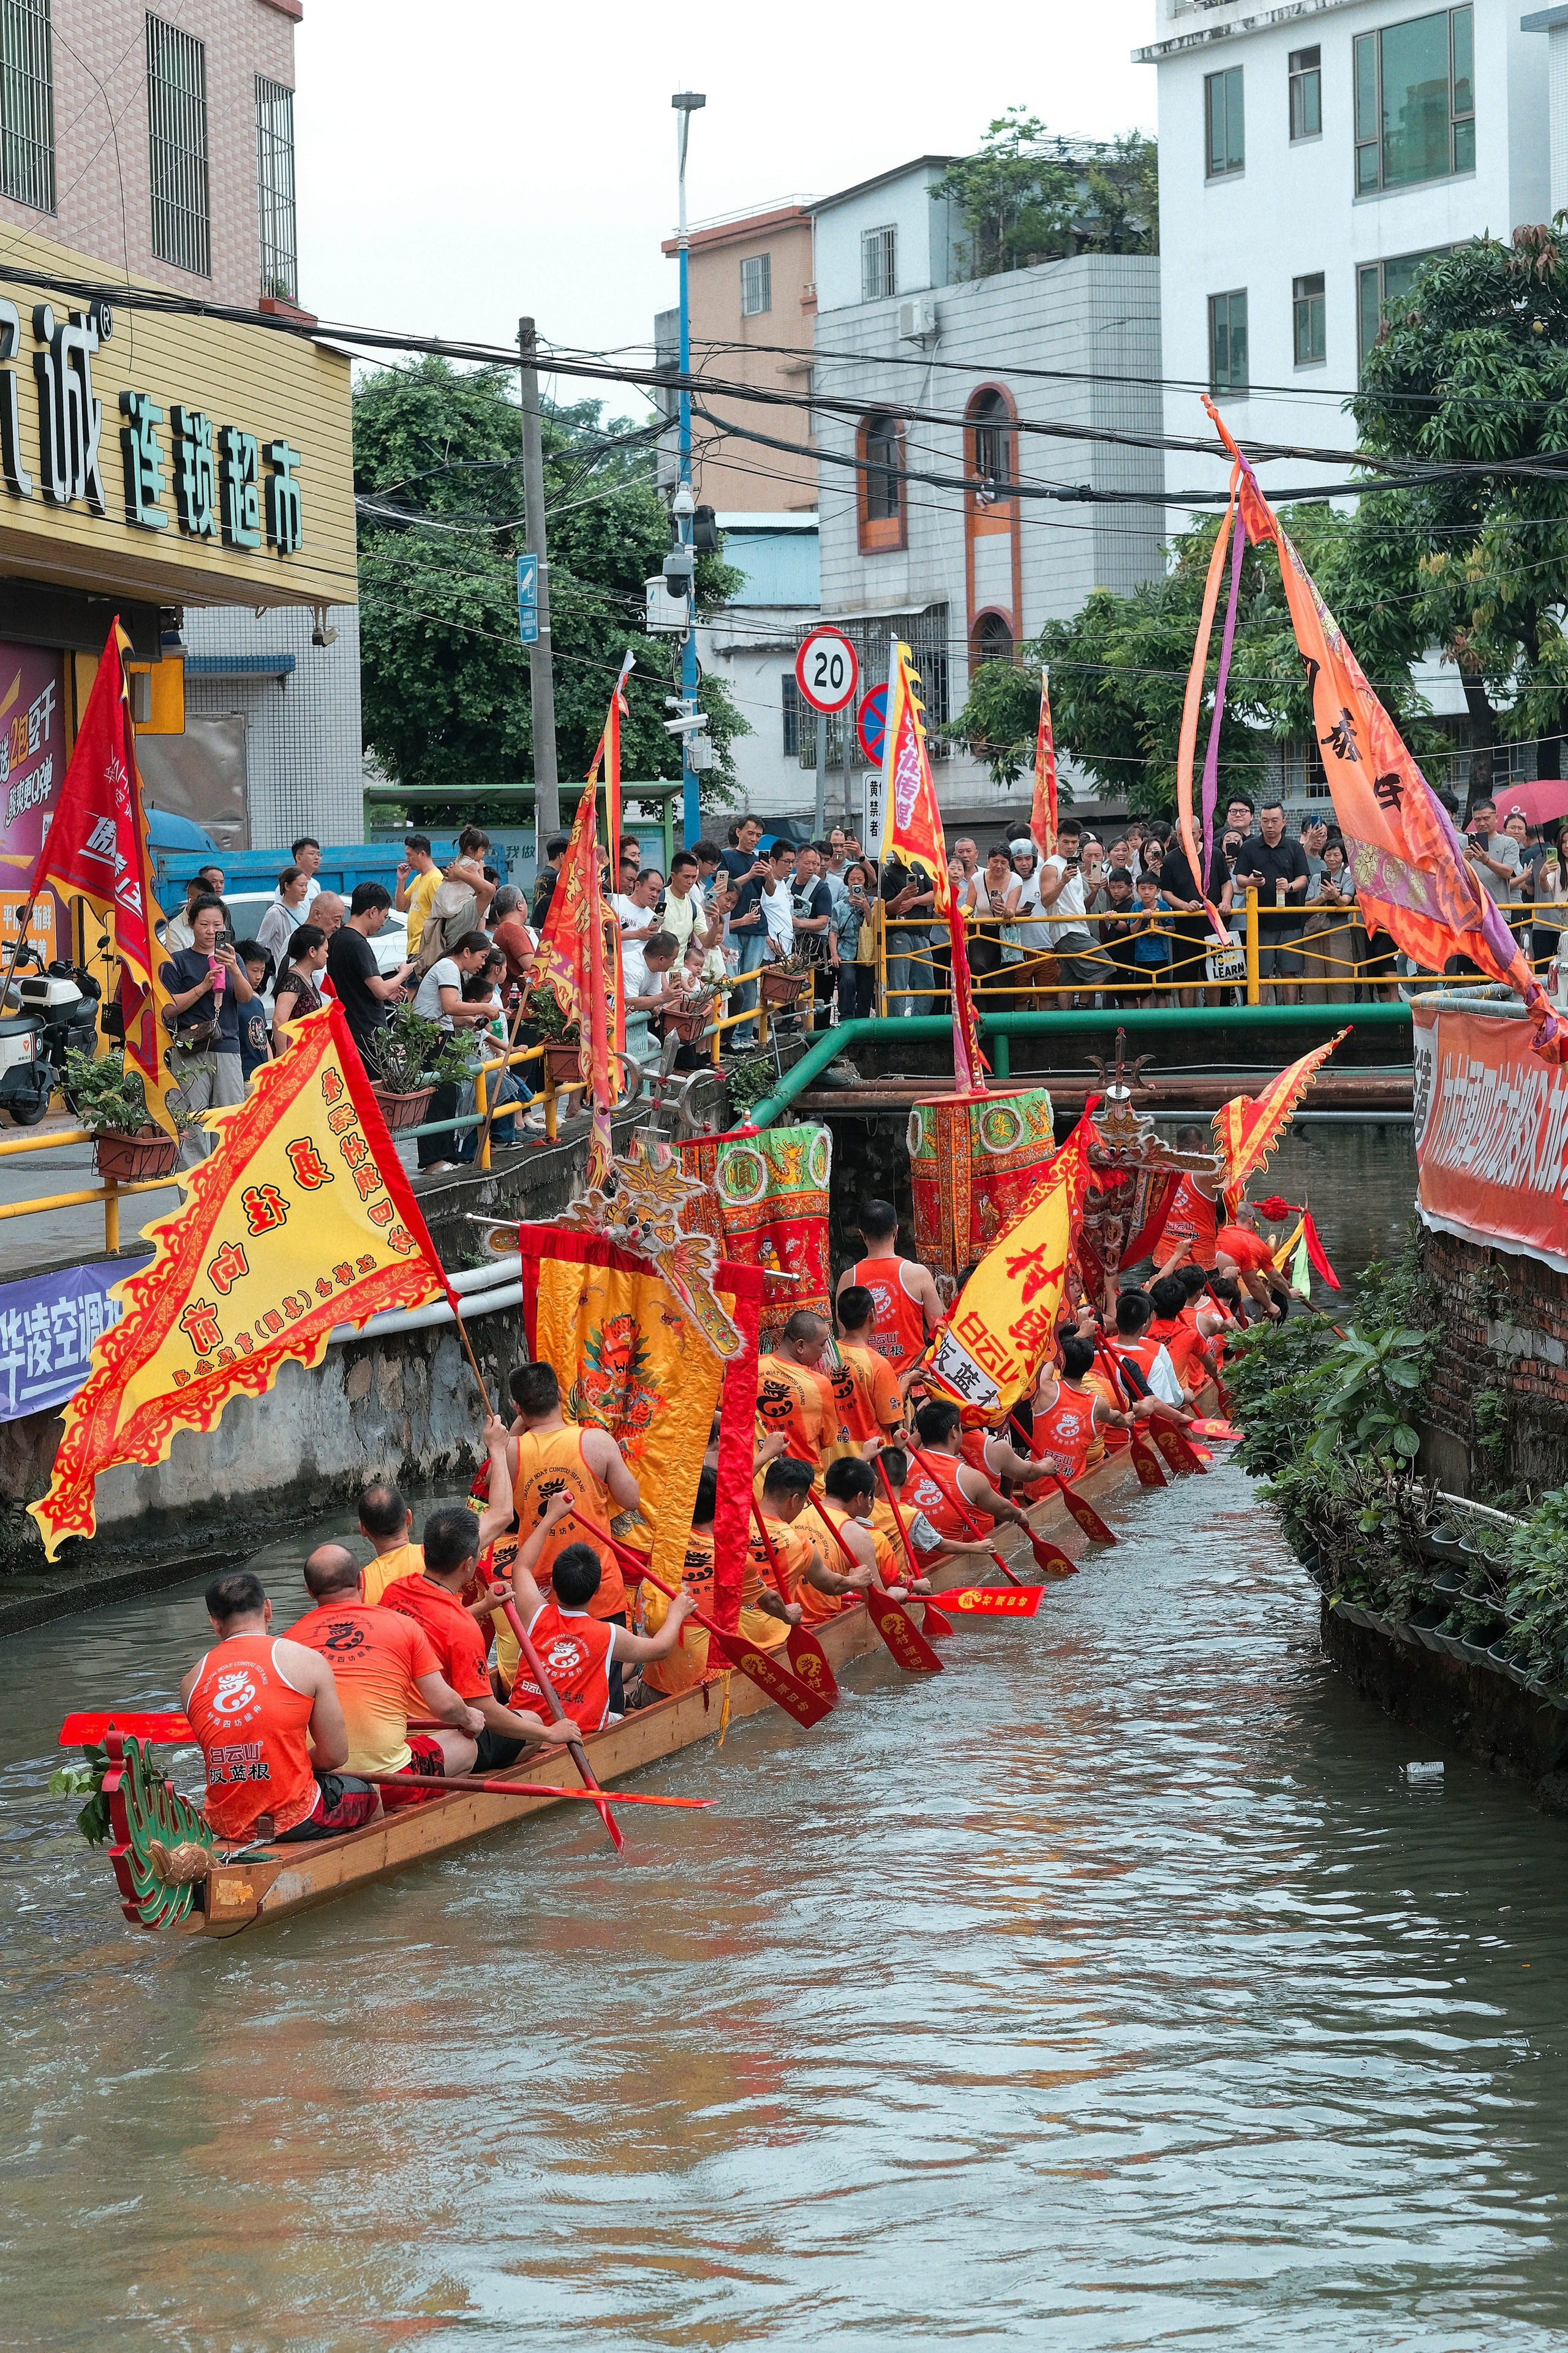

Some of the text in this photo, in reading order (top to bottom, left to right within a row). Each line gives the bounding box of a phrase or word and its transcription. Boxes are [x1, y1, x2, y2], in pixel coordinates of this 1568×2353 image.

[119, 391, 302, 555] 连锁超市
[814, 652, 843, 689] 20
[5, 752, 53, 827] 酸爽更Q弹
[33, 905, 51, 931] 新鲜
[1211, 954, 1224, 967] TO
[1213, 962, 1244, 979] LEARN
[990, 1115, 1011, 1141] 安
[728, 1159, 754, 1189] 順
[957, 1312, 1020, 1384] 白云山
[796, 1386, 805, 1405] SIFANG
[524, 1478, 534, 1500] DRAGON
[533, 1469, 548, 1479] BOAT
[570, 1472, 585, 1492] SIFANG
[981, 1595, 1028, 1607] 村頭四坊
[217, 1663, 233, 1673] BOAT
[255, 1665, 268, 1685] SIFANG
[763, 1672, 809, 1711] 村頭四坊
[209, 1742, 261, 1765] 白云山
[209, 1763, 271, 1785] 板蓝根
